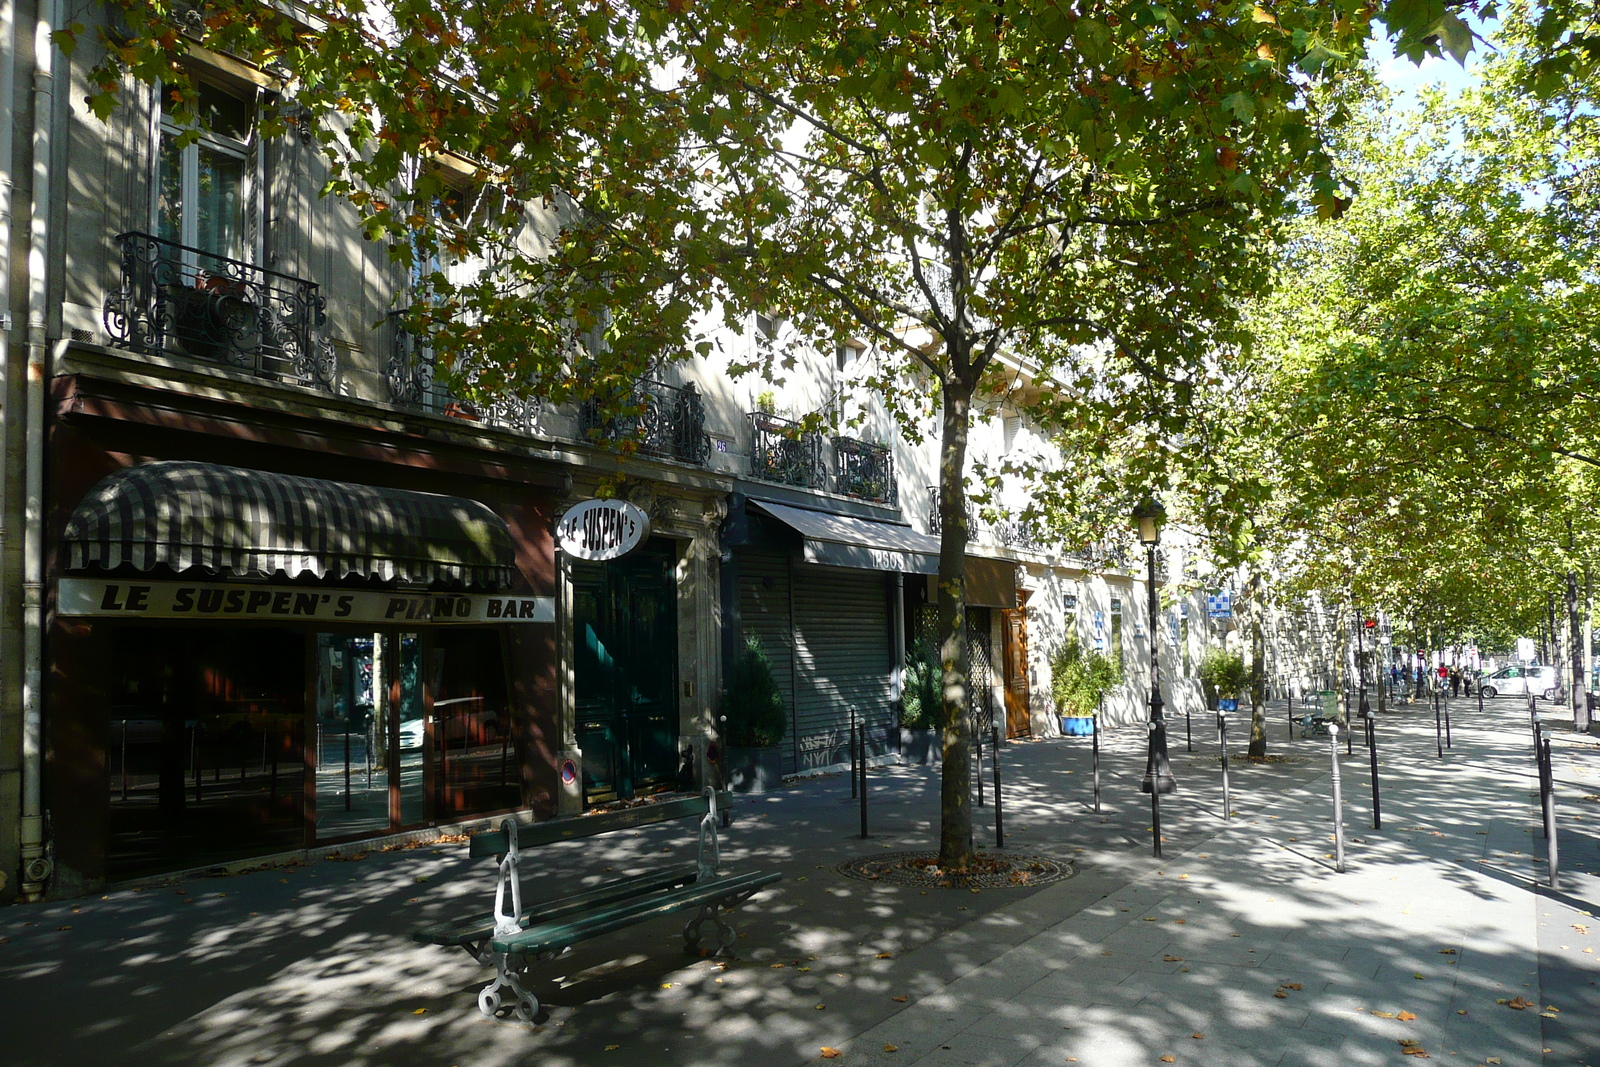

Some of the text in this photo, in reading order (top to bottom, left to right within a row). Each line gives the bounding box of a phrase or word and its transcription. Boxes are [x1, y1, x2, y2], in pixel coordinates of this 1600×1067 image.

[717, 440, 727, 452] 26
[565, 507, 636, 551] LE SUSPEN'S
[101, 584, 536, 620] LE SUSPEN'S PIANO BAR
